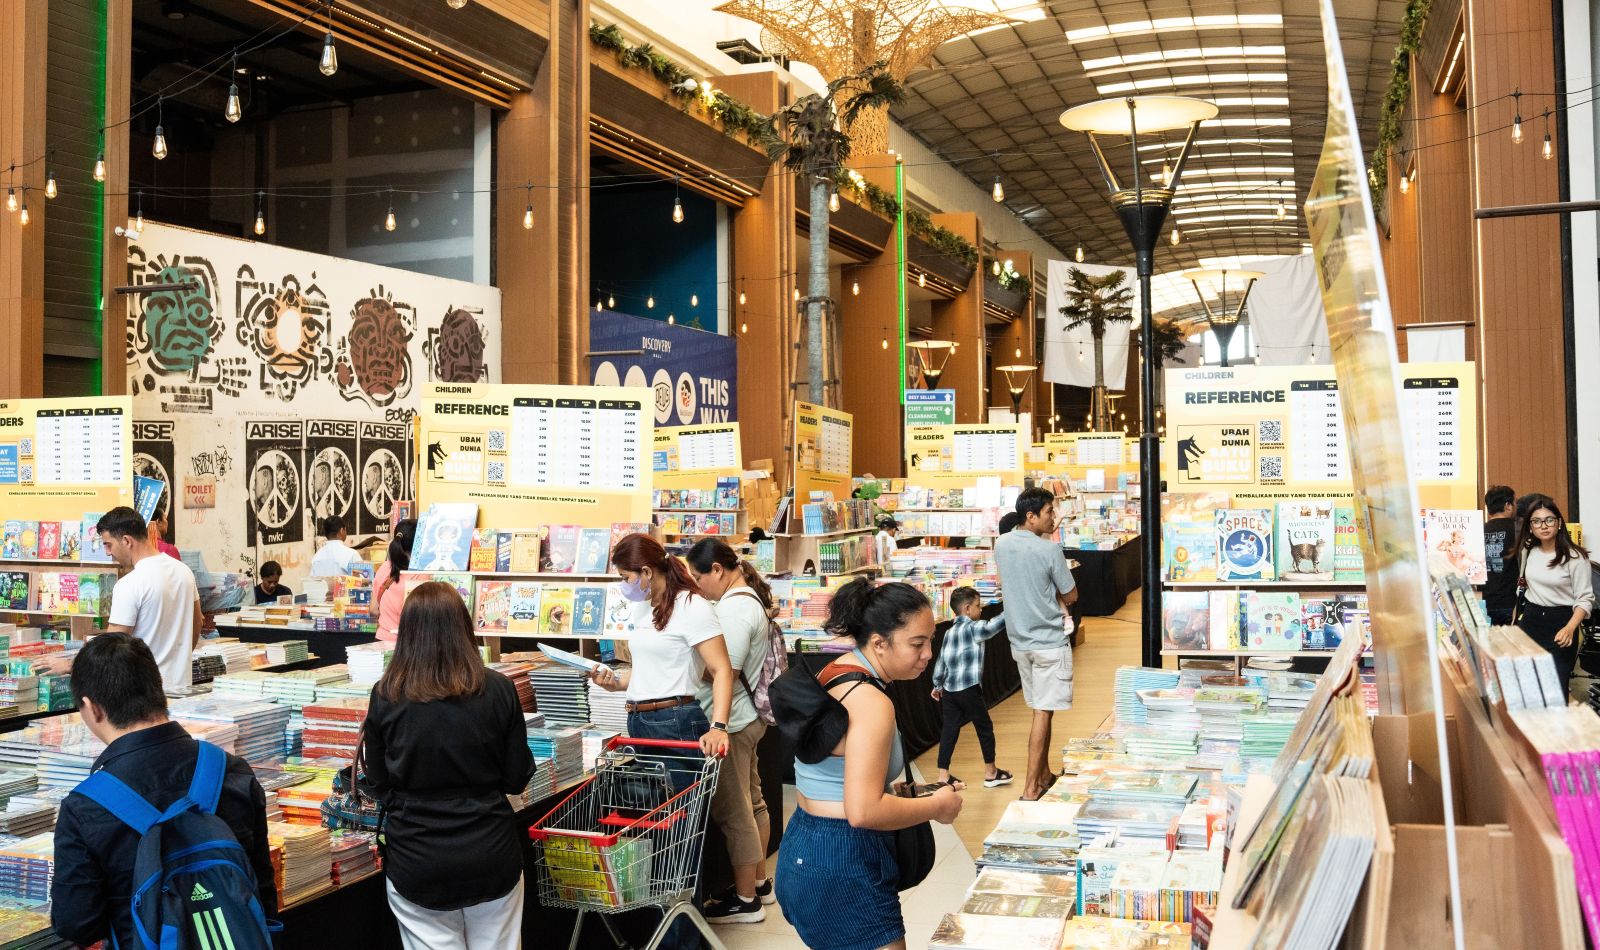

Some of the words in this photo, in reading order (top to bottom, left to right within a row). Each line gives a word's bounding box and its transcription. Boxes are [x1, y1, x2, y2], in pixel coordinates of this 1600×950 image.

[700, 377, 728, 406] THIS
[1185, 390, 1285, 404] REFERENCE
[435, 403, 508, 416] REFERENCE
[800, 416, 817, 426] READERS
[133, 424, 171, 439] RISE
[250, 424, 300, 438] ARISE
[309, 422, 355, 437] ARISE
[363, 424, 404, 439] ARISE
[186, 485, 213, 494] TOILET
[376, 523, 389, 532] nvkr
[1226, 517, 1262, 531] SPACE
[268, 531, 283, 542] nvkr
[1336, 546, 1357, 555] Kids
[191, 891, 213, 902] adidas
